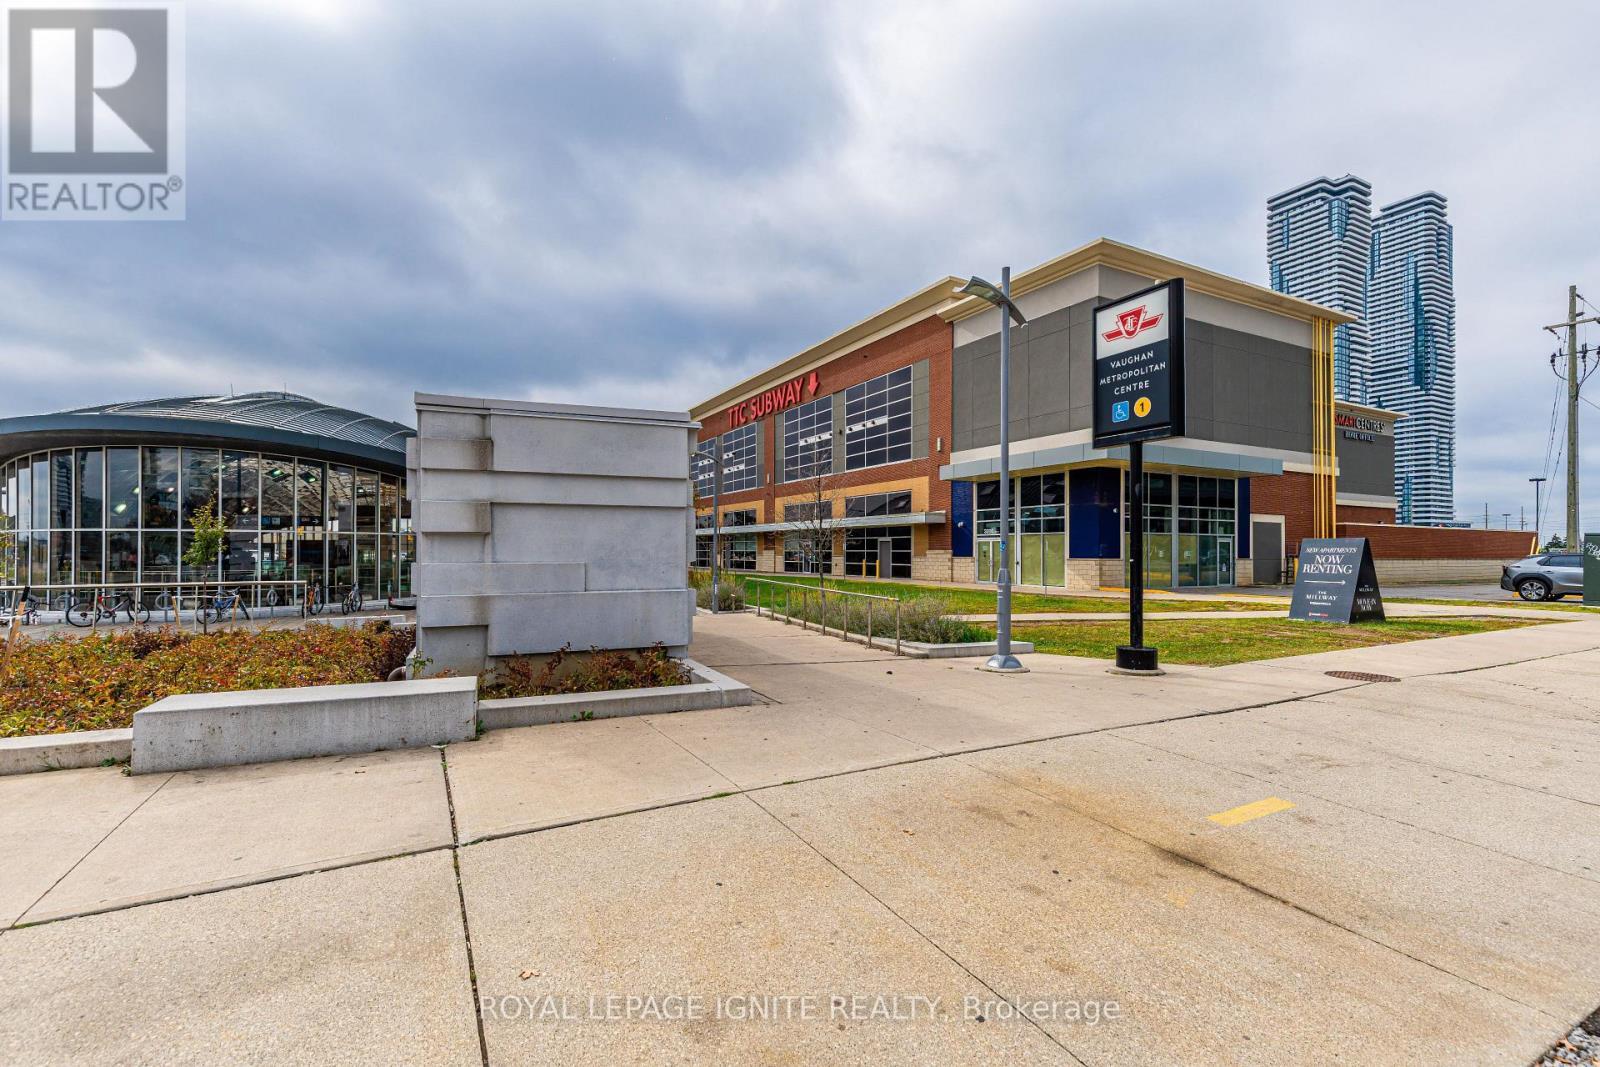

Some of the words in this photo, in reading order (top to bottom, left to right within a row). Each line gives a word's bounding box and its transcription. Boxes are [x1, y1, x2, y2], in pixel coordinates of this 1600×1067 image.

[1110, 350, 1154, 369] VAUGHAN
[1099, 361, 1166, 386] METROPOLITAN
[1114, 380, 1150, 395] CENTRE
[728, 402, 748, 429] TTC
[750, 377, 804, 420] SUBWAY
[1139, 402, 1145, 412] 1
[1314, 554, 1345, 564] NOW
[1302, 563, 1353, 575] RENTING
